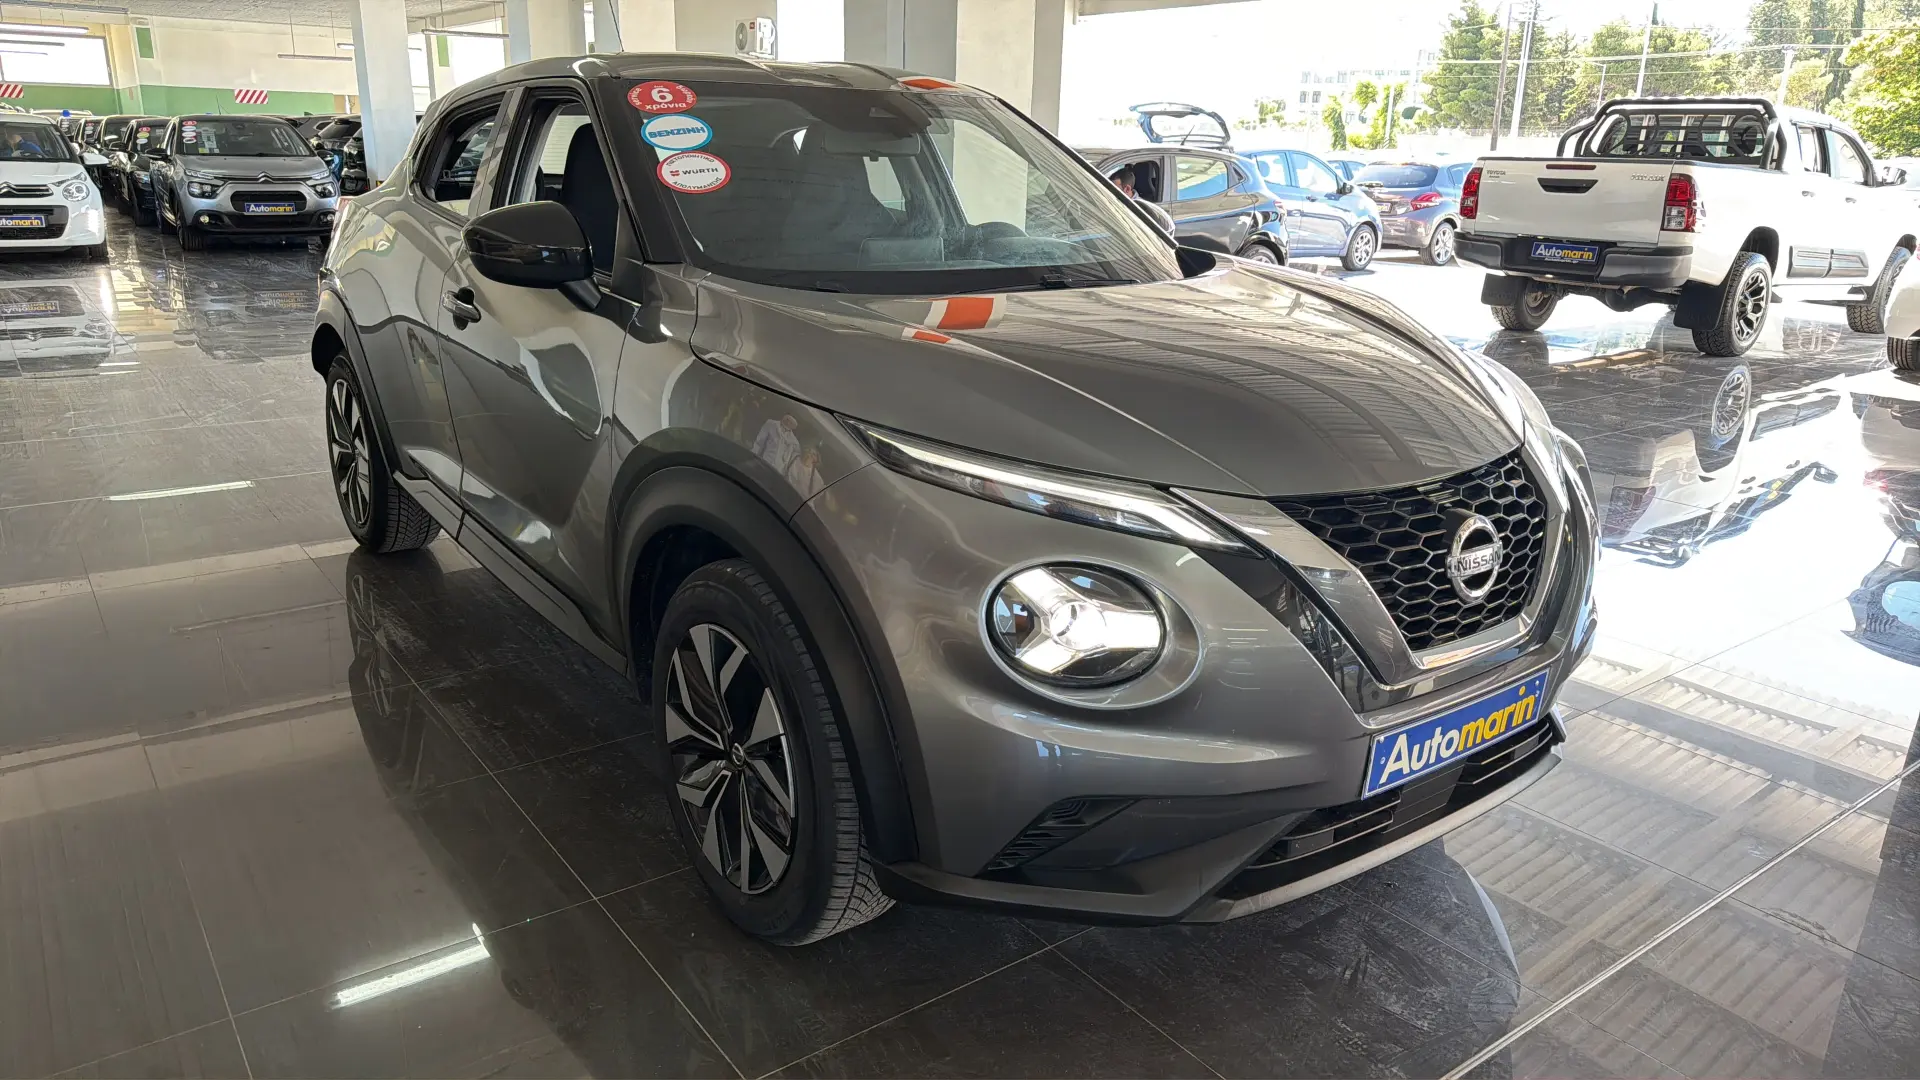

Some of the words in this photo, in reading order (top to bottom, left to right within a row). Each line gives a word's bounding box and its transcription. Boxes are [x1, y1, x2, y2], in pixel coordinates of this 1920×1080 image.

[651, 87, 673, 103] 6
[645, 102, 687, 110] χρόνια
[648, 126, 706, 139] ΒΕΝΖΙΝΗ
[249, 204, 293, 212] Automarin
[1535, 244, 1593, 260] Automarin
[1457, 549, 1504, 572] NISSAN
[1378, 685, 1536, 785] Automarin
